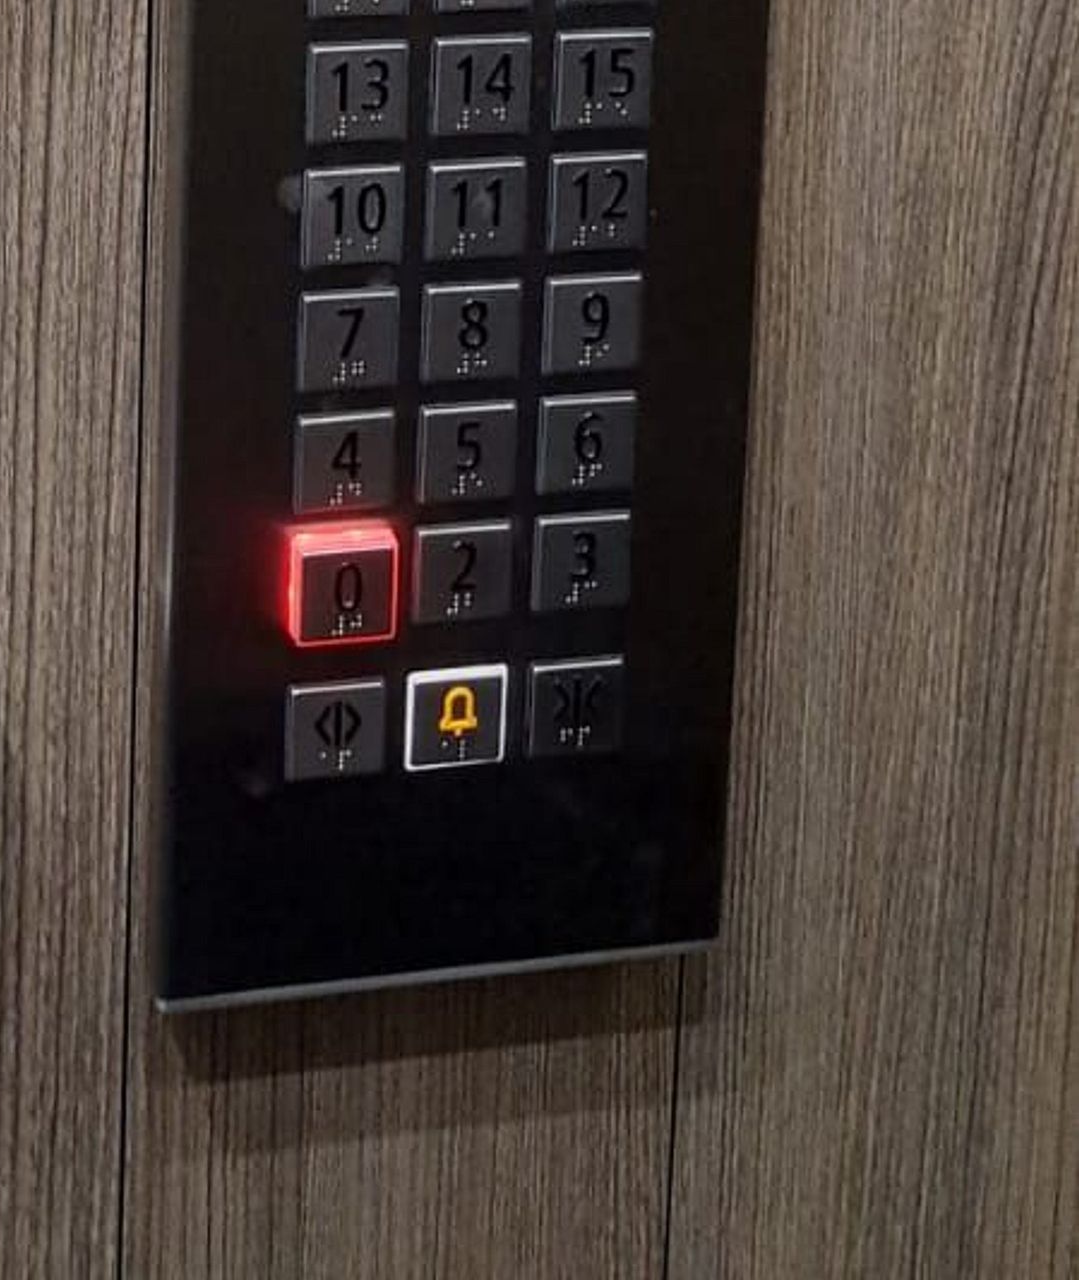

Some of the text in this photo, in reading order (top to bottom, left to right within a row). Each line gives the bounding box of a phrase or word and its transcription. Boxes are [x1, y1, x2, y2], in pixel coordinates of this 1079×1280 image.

[332, 59, 389, 112] 13
[457, 53, 515, 105] 14
[580, 48, 634, 100] 15
[327, 182, 386, 236] 10
[452, 177, 504, 229] 11
[573, 169, 629, 221] 12
[338, 307, 364, 358] 7
[459, 299, 488, 351] 8
[582, 292, 610, 344] 9
[331, 431, 361, 481] 4
[456, 422, 481, 472] 5
[575, 413, 602, 464] 6
[453, 542, 477, 592] 2
[572, 533, 597, 583] 3
[335, 563, 362, 615] 0
